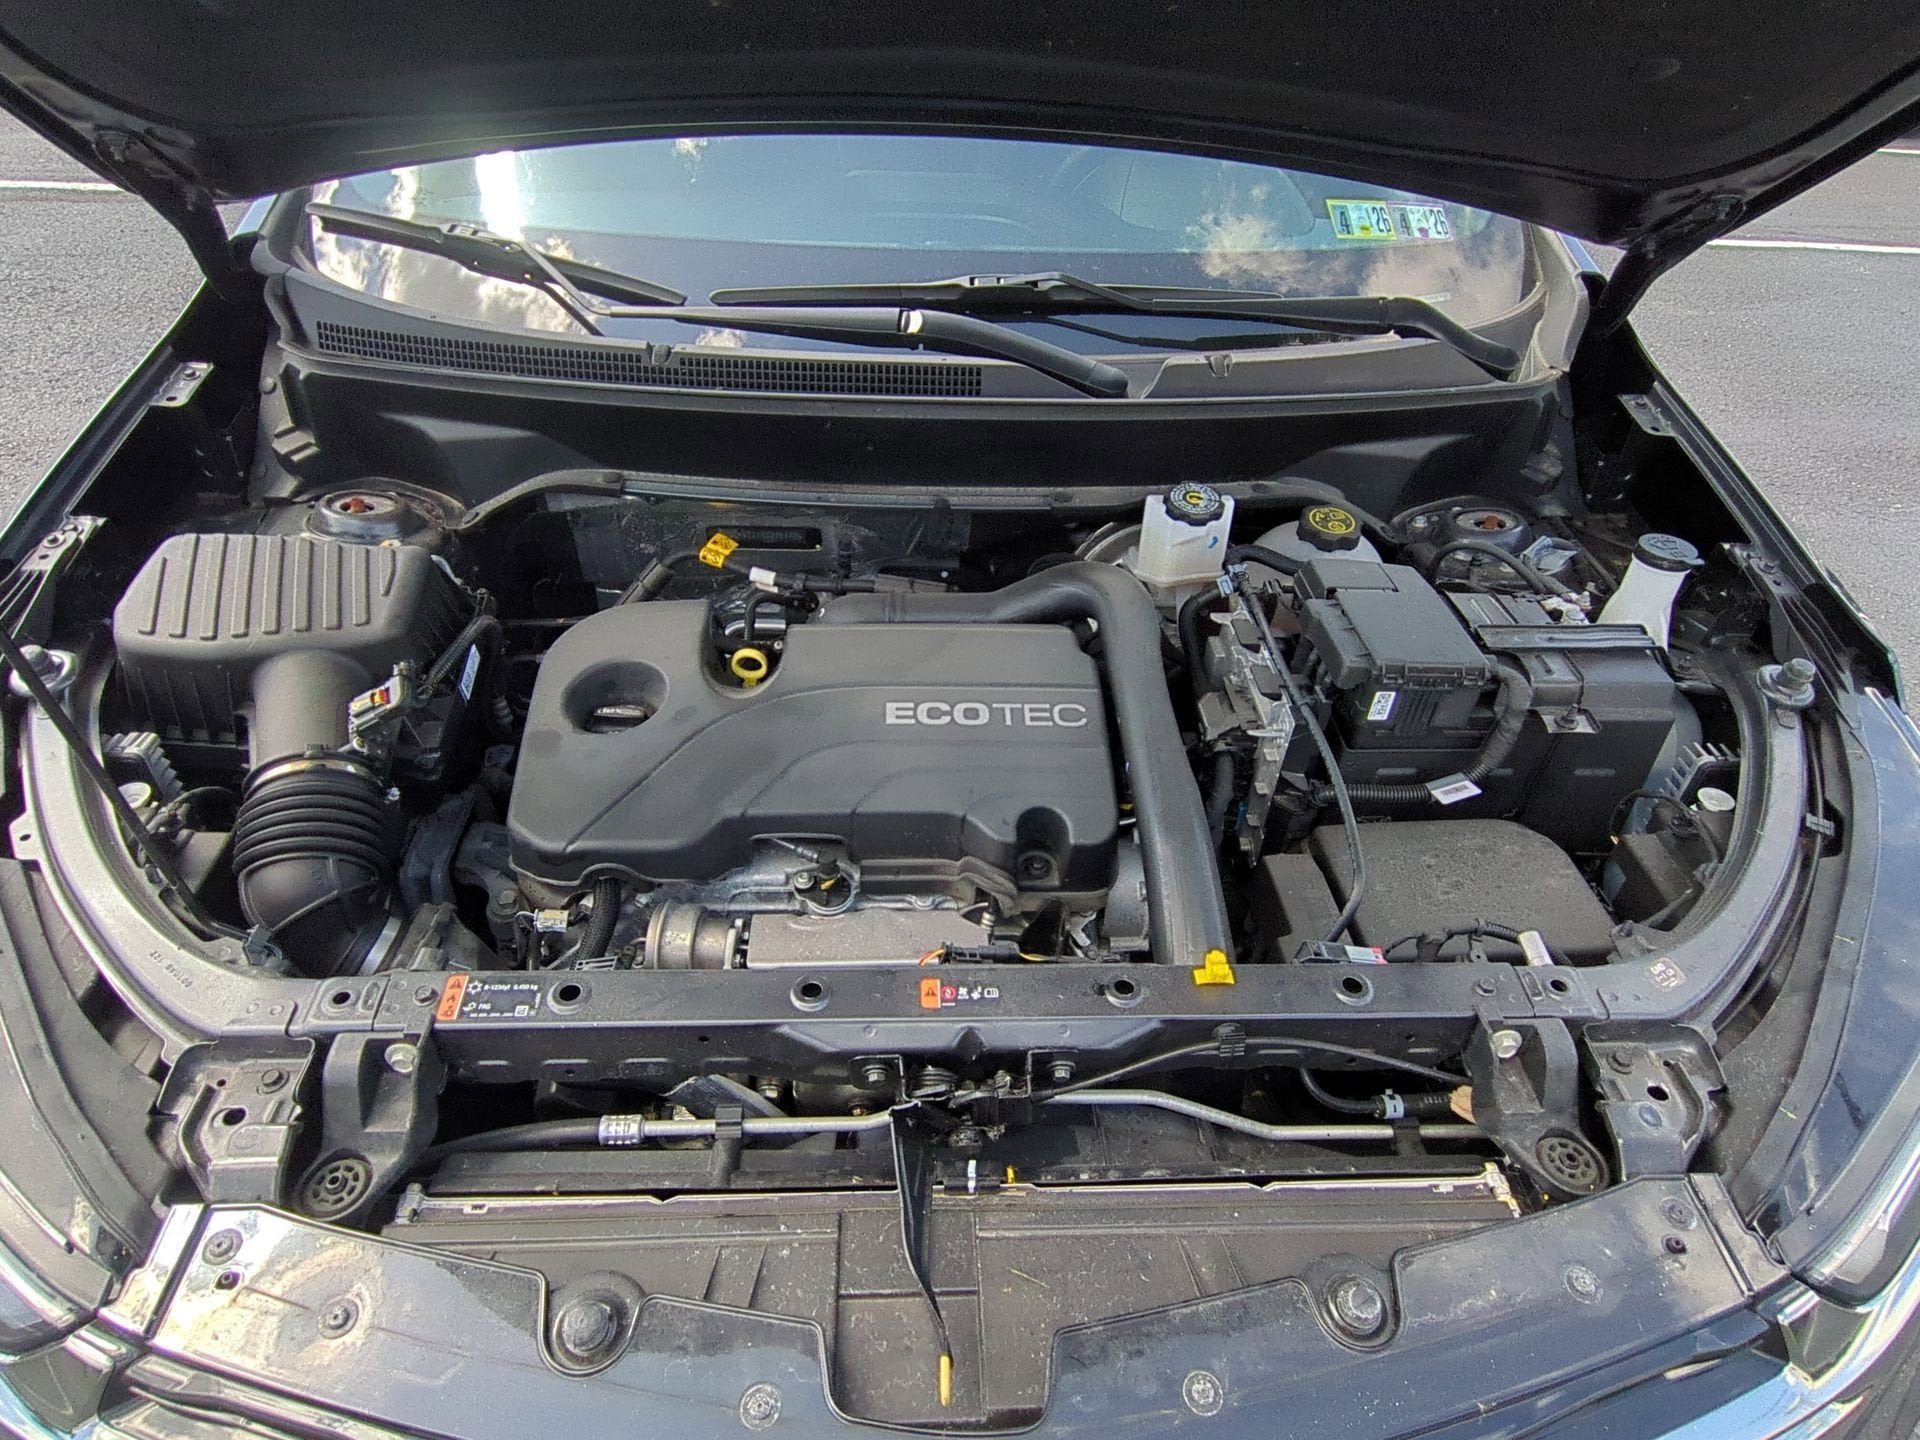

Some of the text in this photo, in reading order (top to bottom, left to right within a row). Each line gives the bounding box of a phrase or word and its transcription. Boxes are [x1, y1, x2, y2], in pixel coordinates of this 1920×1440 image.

[1340, 206, 1392, 234] 4 26
[1400, 209, 1449, 236] 4 26
[885, 701, 1088, 727] ECOTEC
